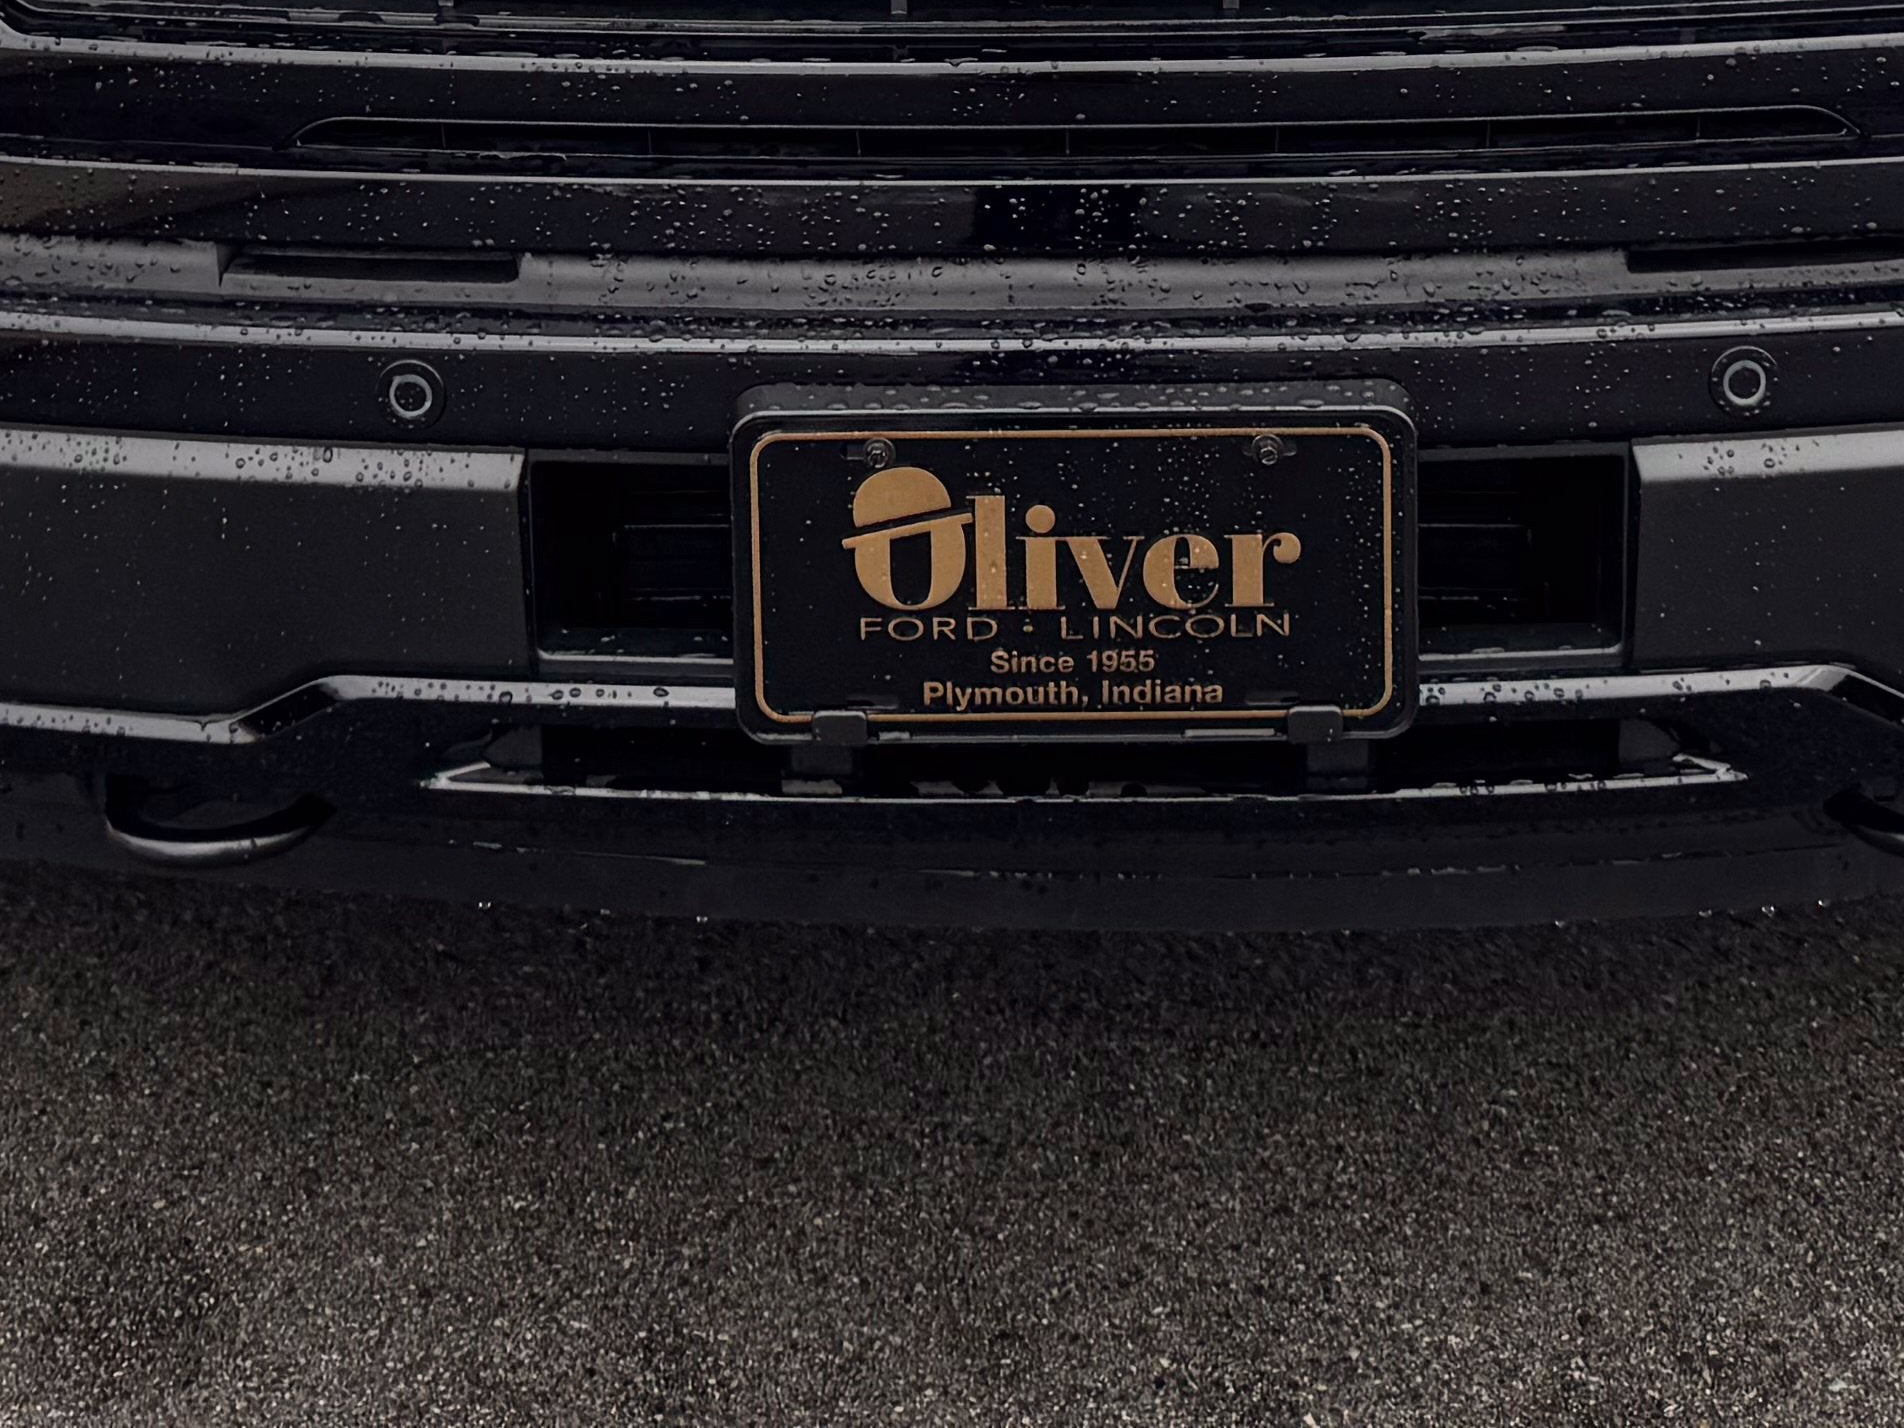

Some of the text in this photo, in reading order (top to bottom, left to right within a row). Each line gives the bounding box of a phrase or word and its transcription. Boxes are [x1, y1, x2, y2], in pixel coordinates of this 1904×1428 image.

[841, 466, 1302, 612] Oliver
[860, 612, 1291, 642] FORD LINCOLN
[990, 649, 1156, 674] Since 1955
[922, 678, 1224, 712] Plymouth, Indiana
